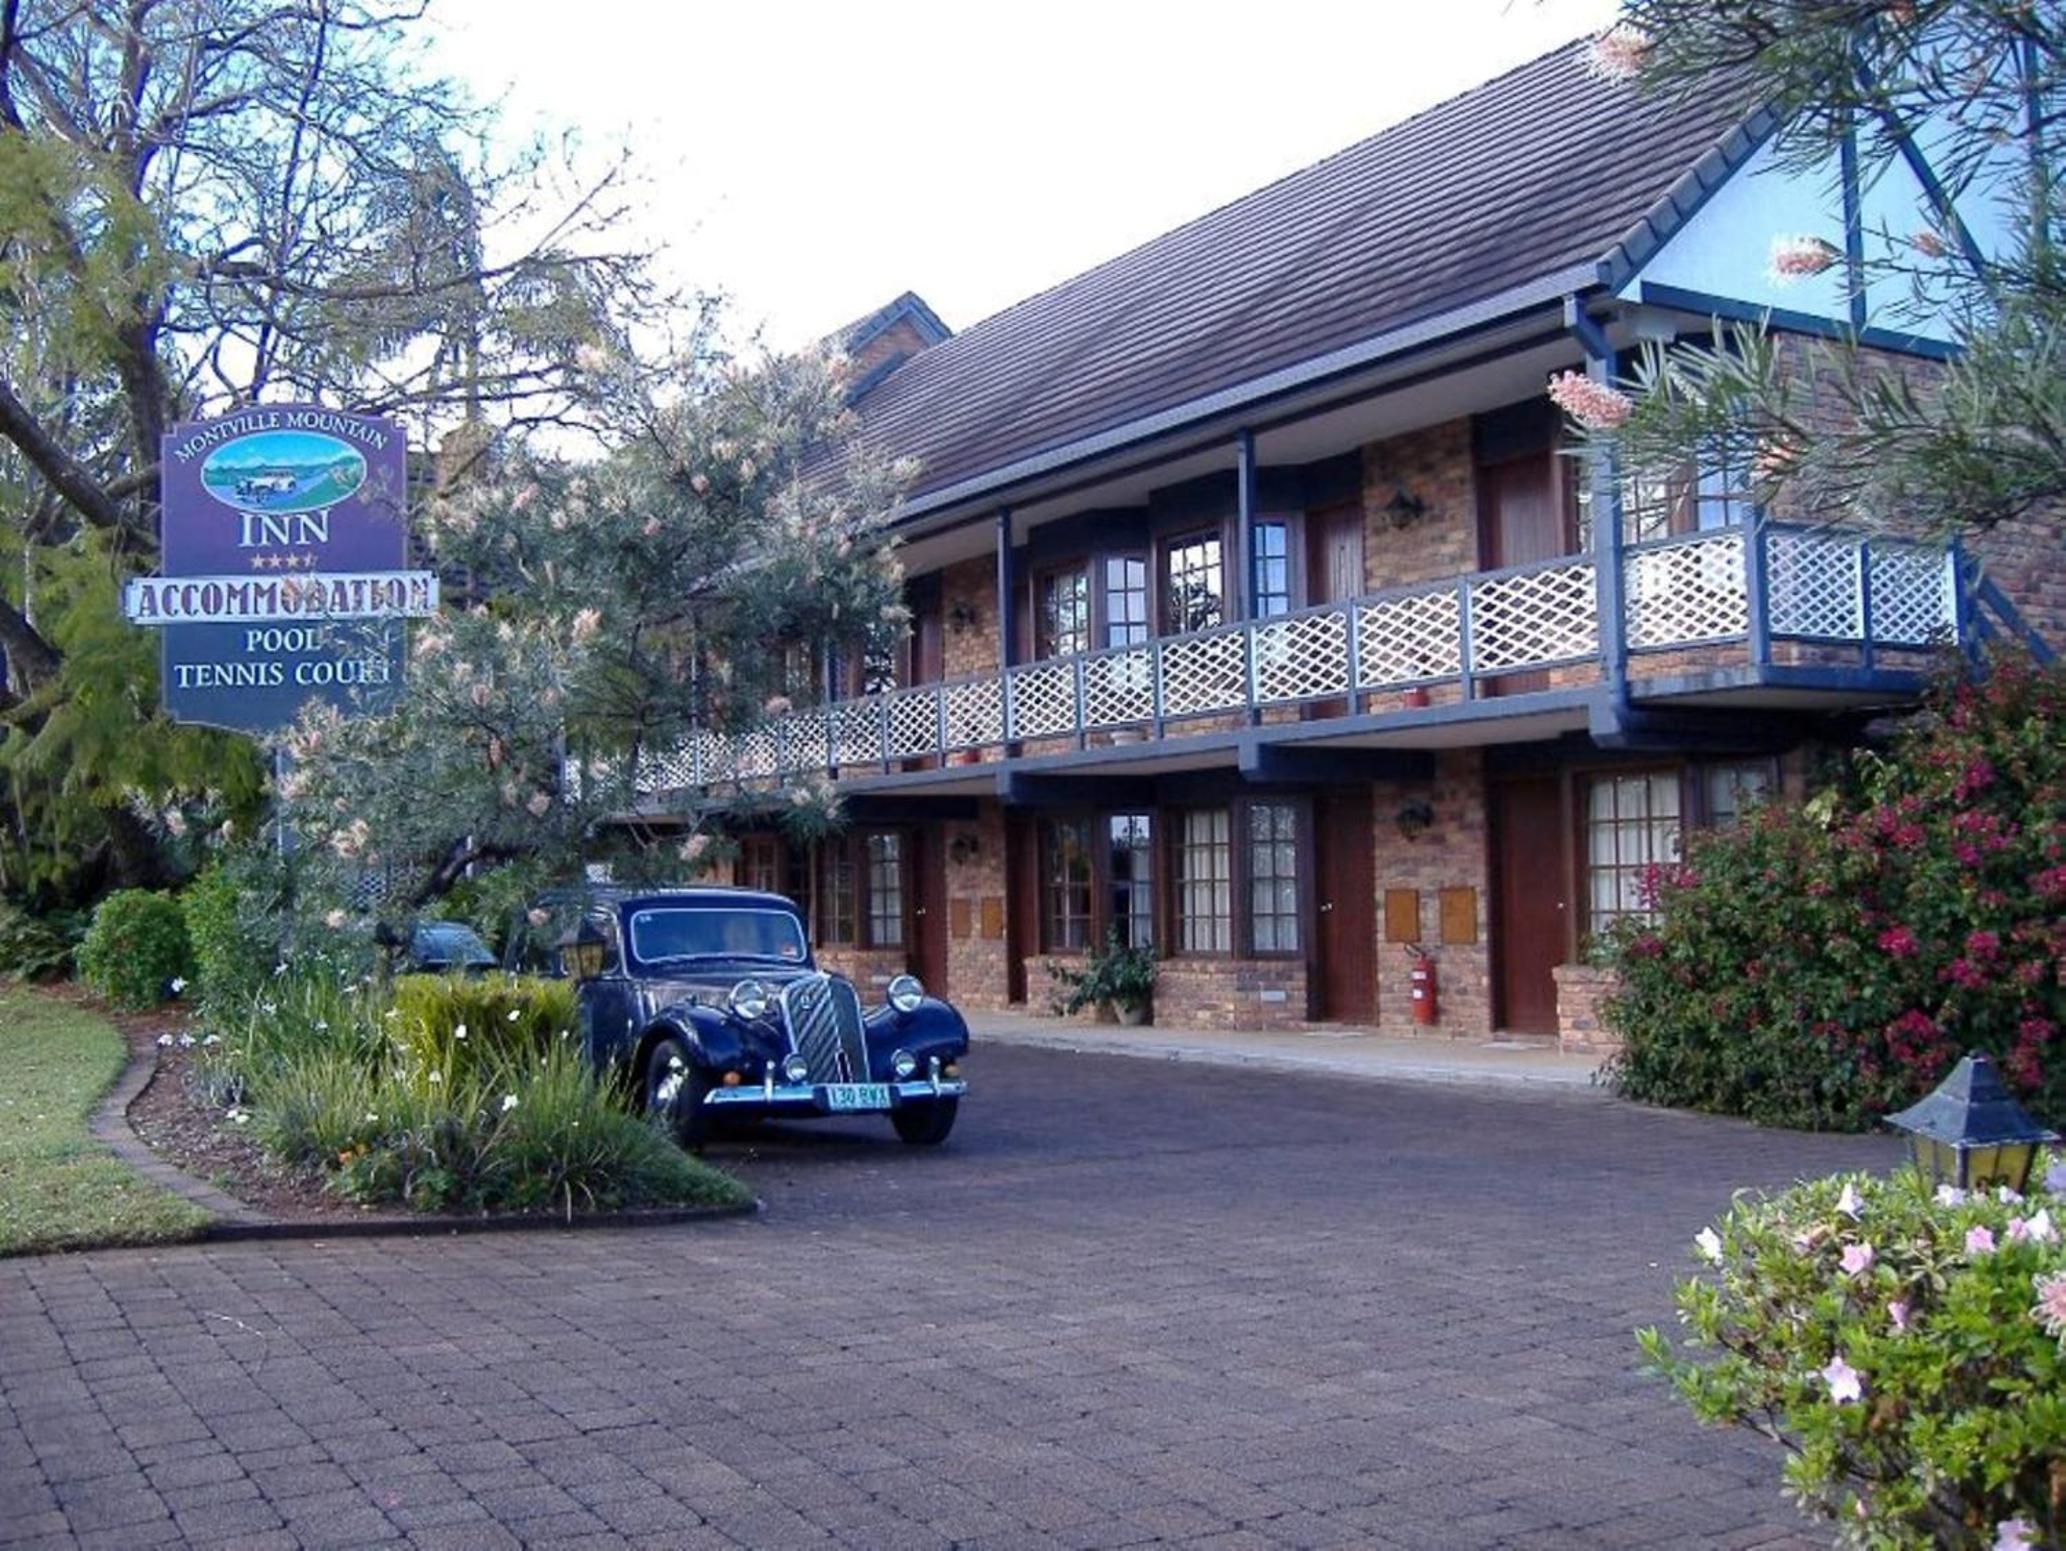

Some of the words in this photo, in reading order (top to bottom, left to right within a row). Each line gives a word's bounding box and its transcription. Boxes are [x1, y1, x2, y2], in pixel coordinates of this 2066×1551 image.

[174, 412, 281, 463] MONTVILLE
[287, 412, 388, 450] MOUNTAIN
[237, 509, 331, 548] INN
[246, 628, 322, 651] POOL
[174, 661, 284, 688] TENNIS
